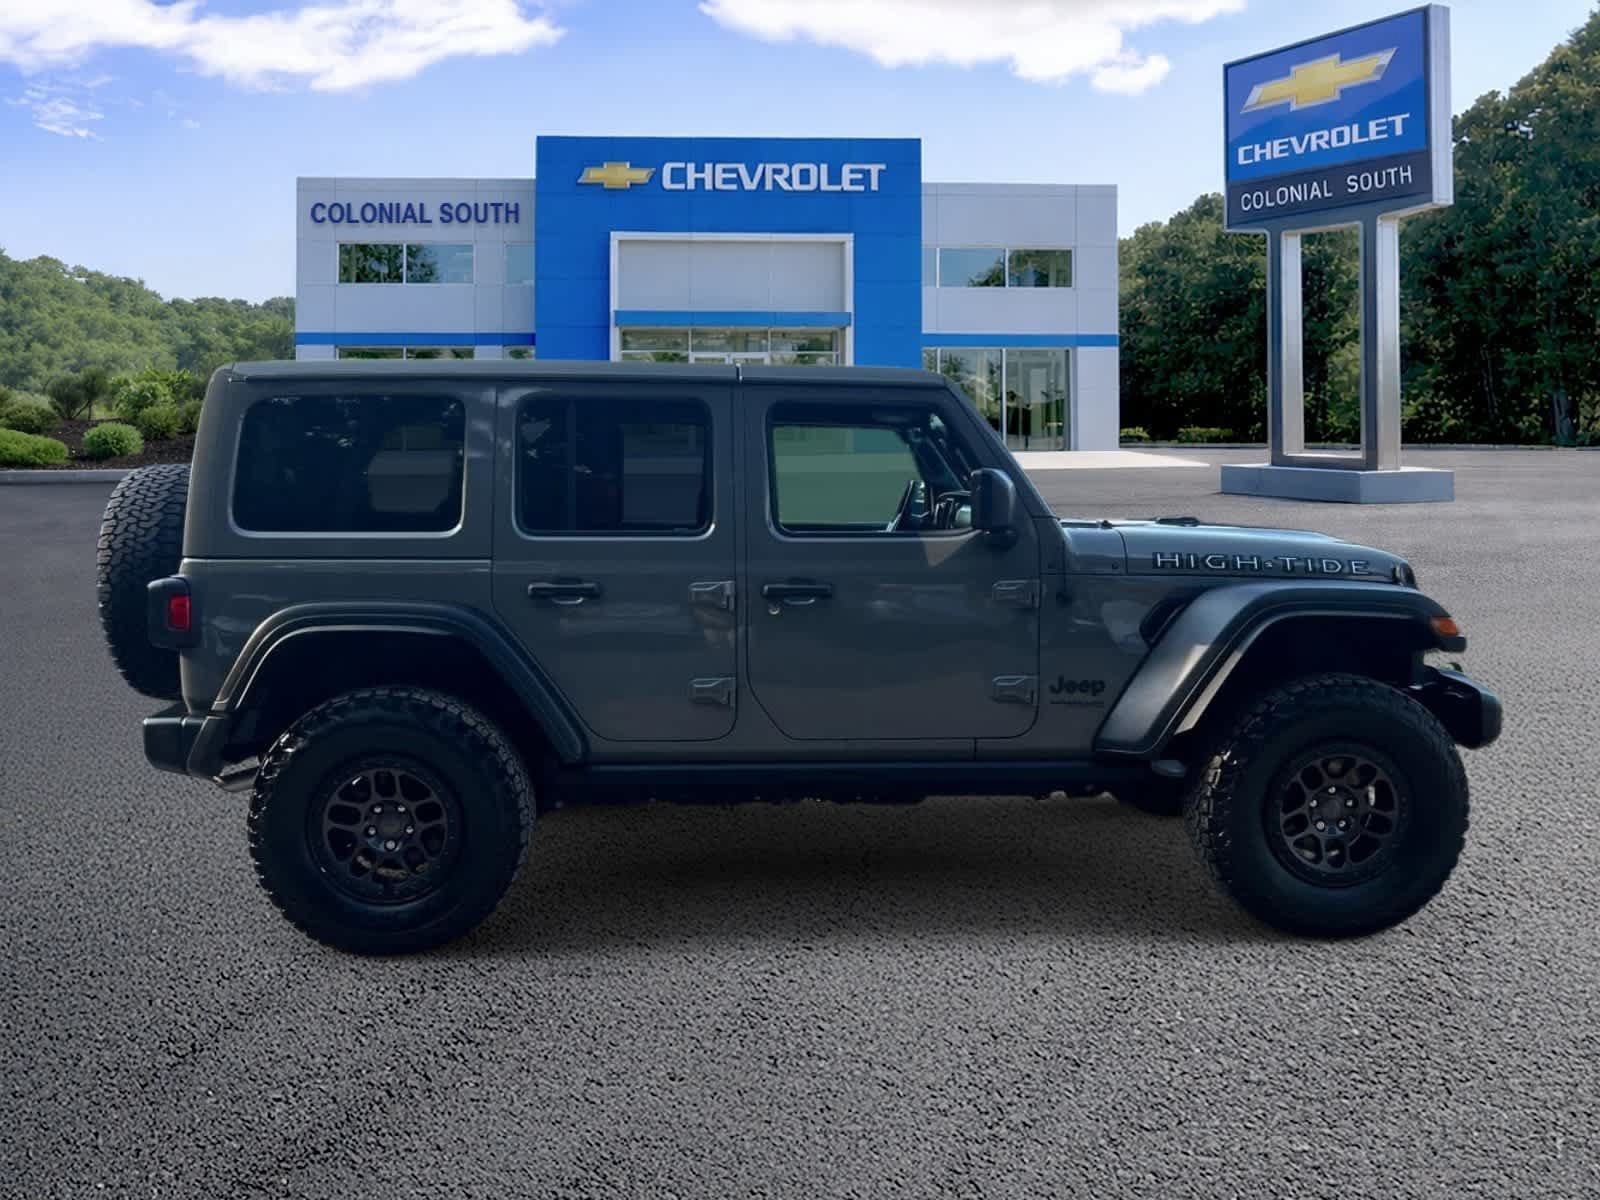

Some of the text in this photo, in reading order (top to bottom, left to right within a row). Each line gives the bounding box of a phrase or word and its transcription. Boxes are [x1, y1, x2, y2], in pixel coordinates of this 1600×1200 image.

[1237, 113, 1410, 165] CHEVROLET
[662, 162, 887, 192] CHEVROLET
[1240, 165, 1413, 212] COLONIAL SOUTH
[310, 203, 520, 224] COLONIAL SOUTH
[1049, 674, 1105, 697] Jeep
